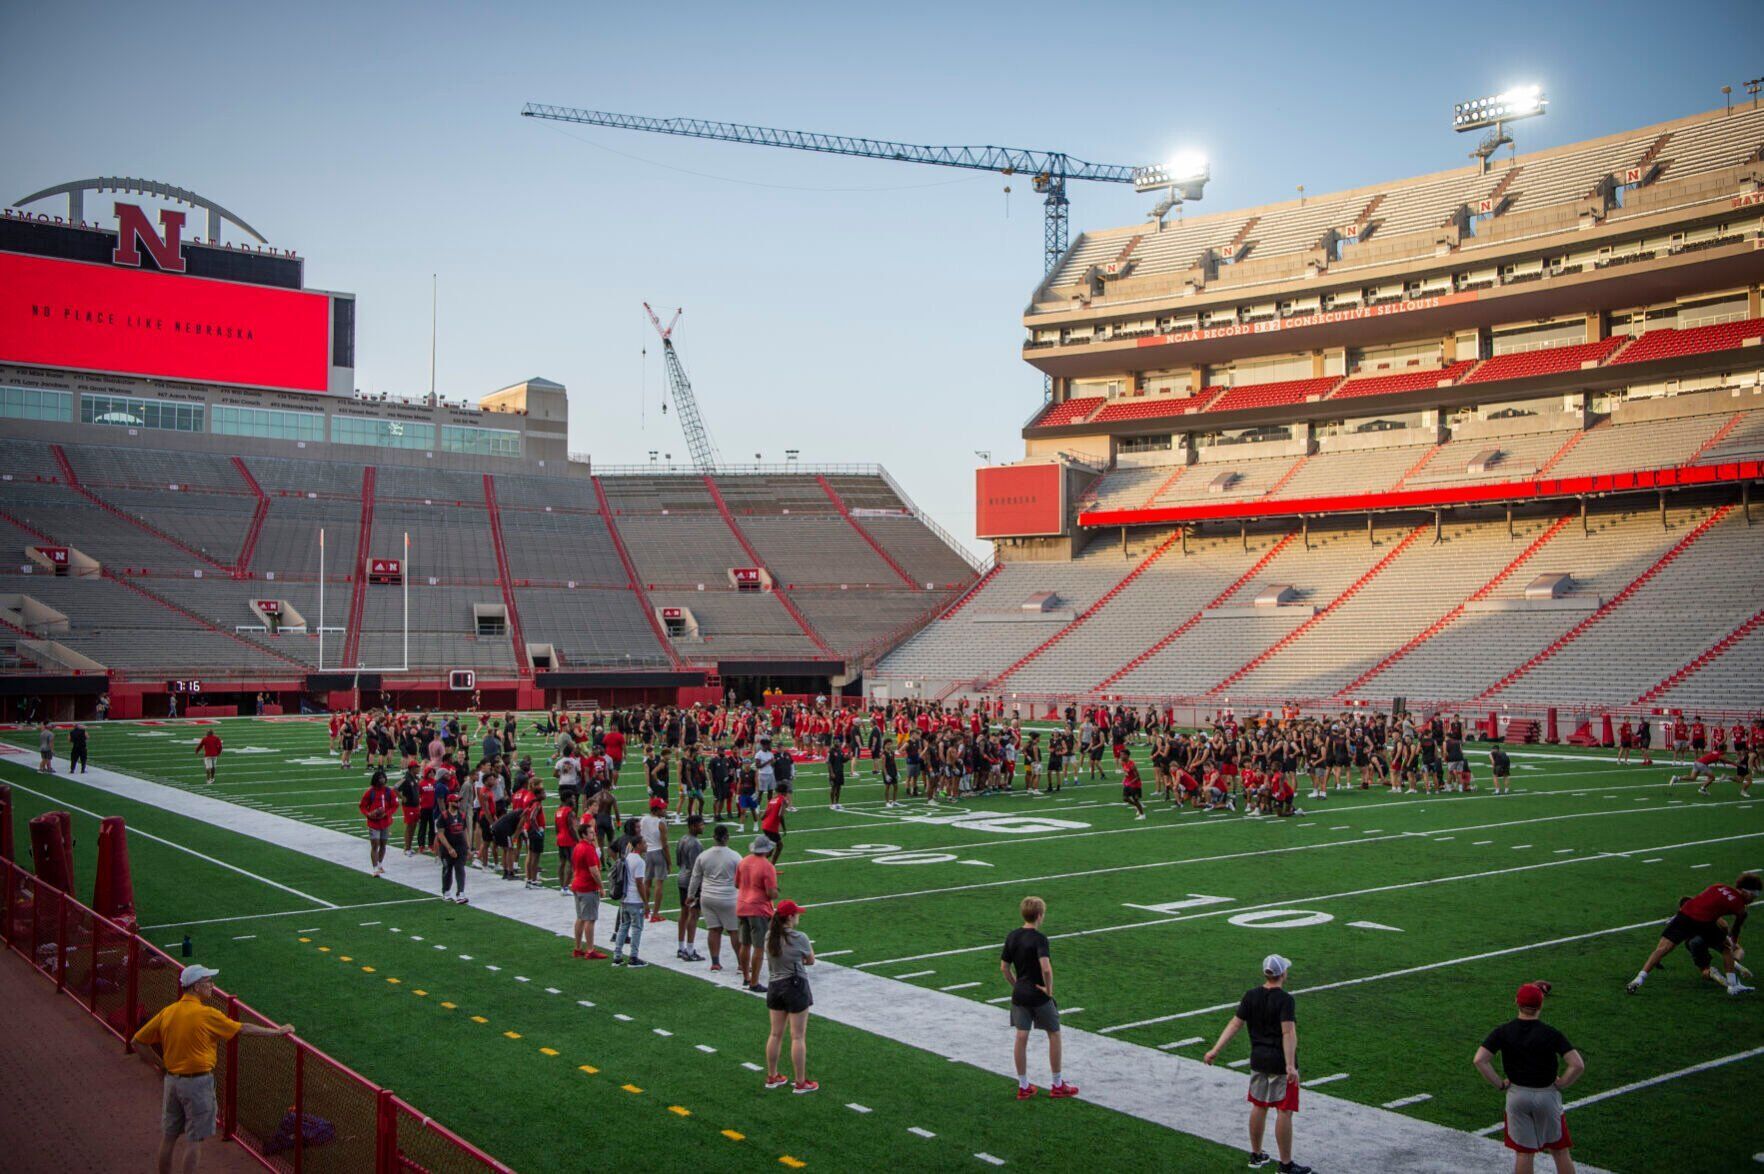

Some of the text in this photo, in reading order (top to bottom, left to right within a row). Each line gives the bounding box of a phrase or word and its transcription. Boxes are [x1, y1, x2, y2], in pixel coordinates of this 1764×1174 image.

[112, 201, 186, 273] N
[193, 236, 297, 260] STADIUM
[32, 305, 254, 340] NO PLACE LIKE NEBRASKA
[1166, 330, 1199, 344] NCAA
[1203, 324, 1249, 339] RECORD
[1286, 307, 1371, 328] CONSECUTIVE
[1378, 298, 1439, 315] SELLOUTS
[1592, 469, 1681, 491] PLACE
[176, 681, 200, 692] 7:16
[804, 844, 957, 865] 20
[1121, 893, 1334, 928] 10
